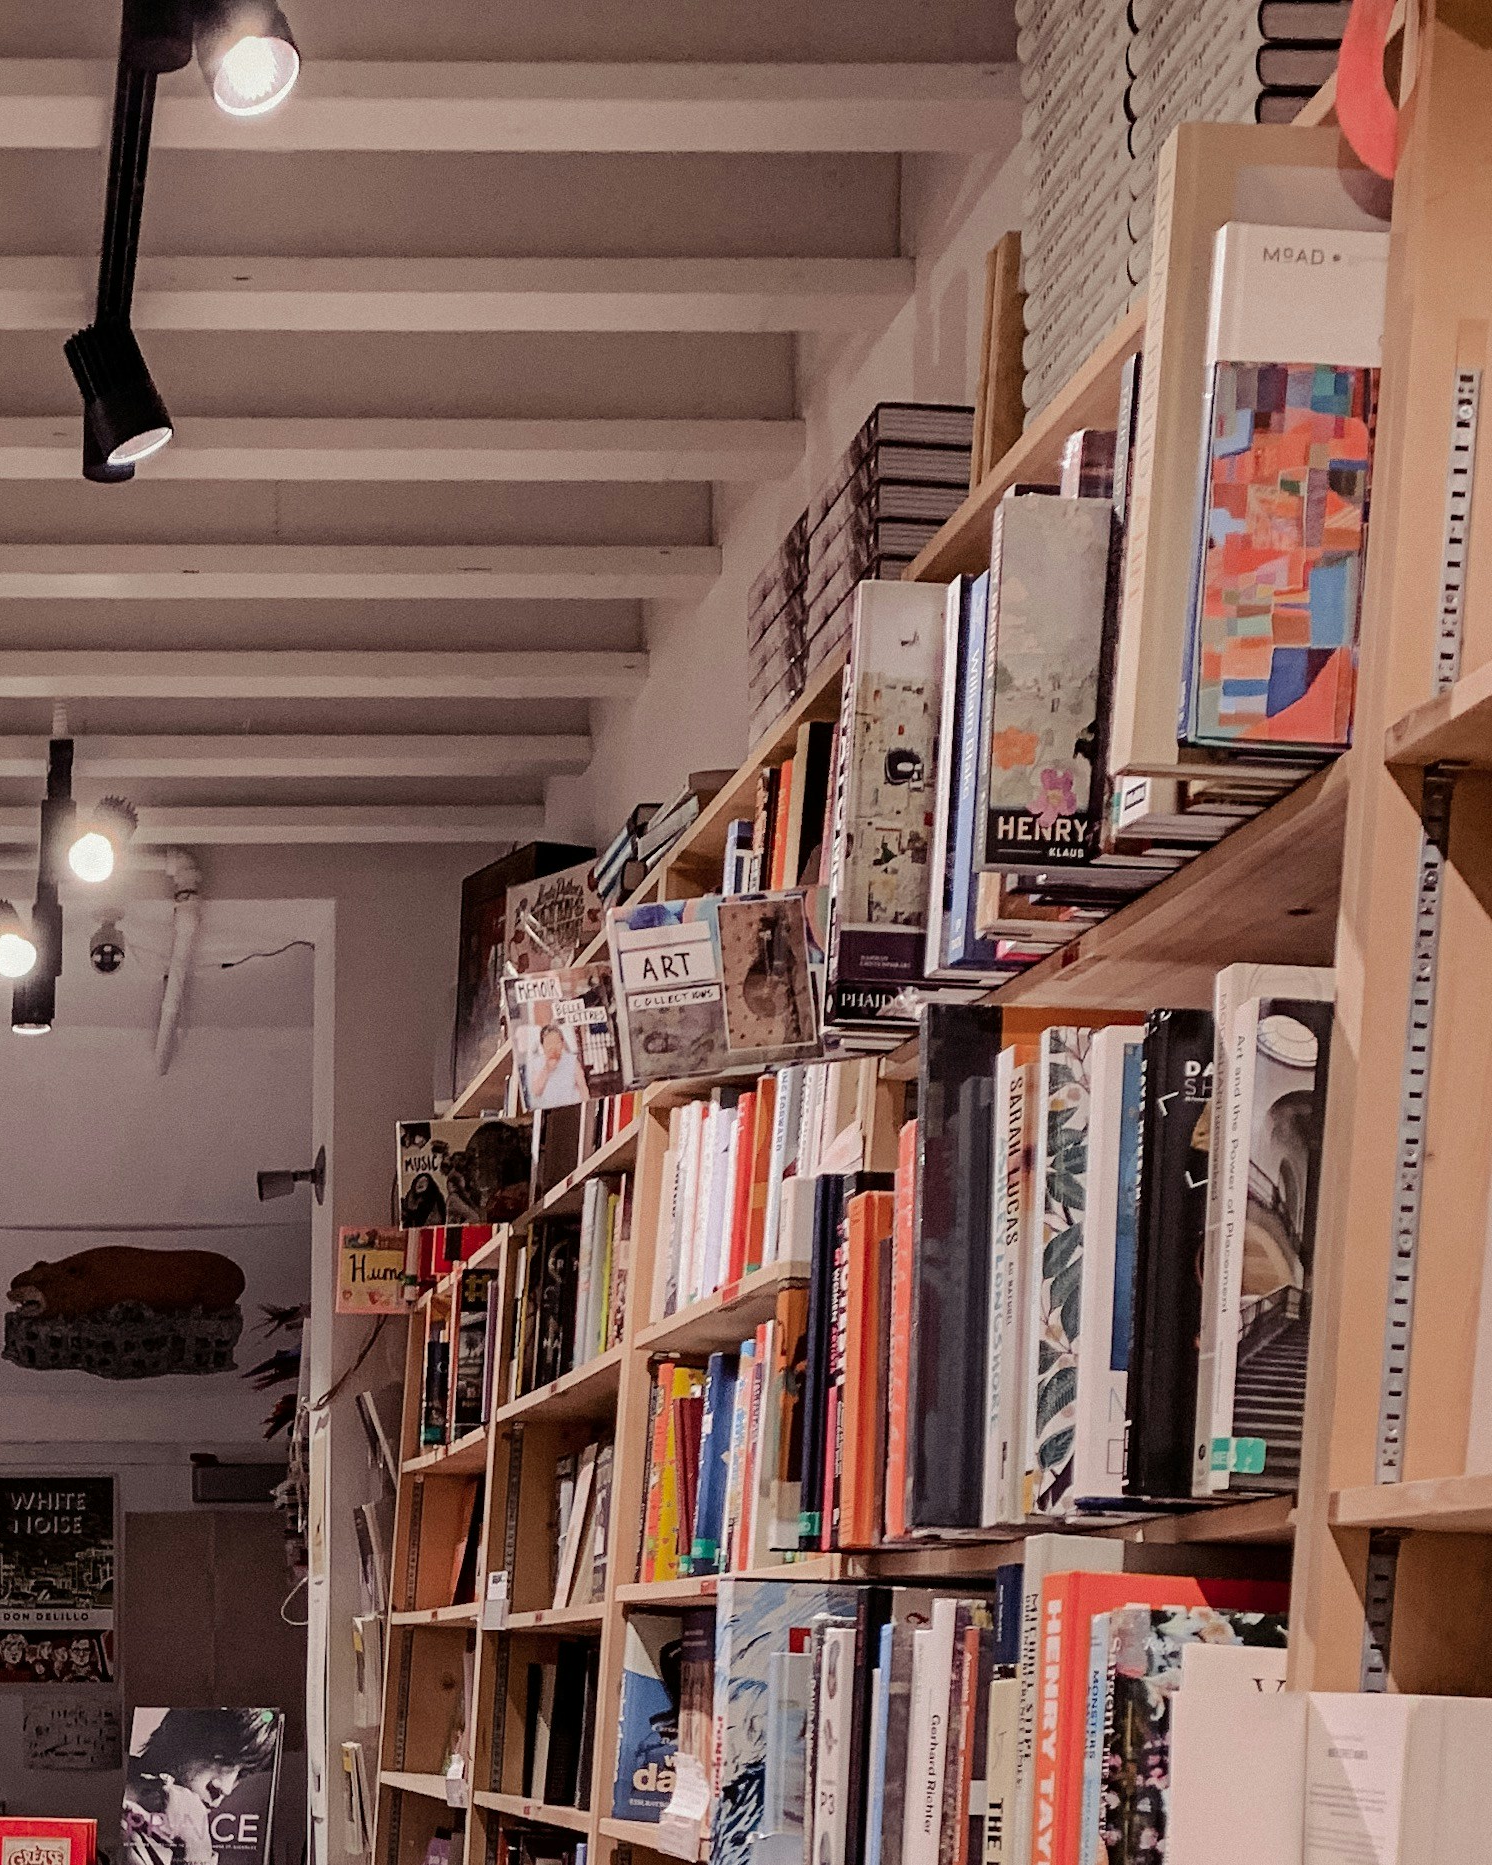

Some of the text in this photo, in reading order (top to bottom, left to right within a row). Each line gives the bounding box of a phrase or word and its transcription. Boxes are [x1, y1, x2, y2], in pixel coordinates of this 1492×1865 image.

[963, 648, 980, 799] William Blake
[997, 815, 1088, 843] HENRY
[1048, 847, 1085, 859] KLAUS
[641, 952, 691, 981] ART
[516, 978, 557, 999] MEMOIR
[632, 988, 714, 1009] COLLECTIONS
[555, 999, 584, 1016] BELLE
[405, 1155, 439, 1172] MUSIC
[1005, 1076, 1024, 1247] SARAH LUCAS
[1220, 1035, 1246, 1314] Art and the Power of Placement
[11, 1492, 87, 1511] WHITE
[11, 1516, 83, 1535] NOISE
[3, 1611, 90, 1622] DON DELILLO
[1042, 1599, 1063, 1763] HENRY
[1088, 1669, 1101, 1760] MONSTERS
[922, 1713, 941, 1836] Gerhard Richter
[986, 1797, 1004, 1851] THE
